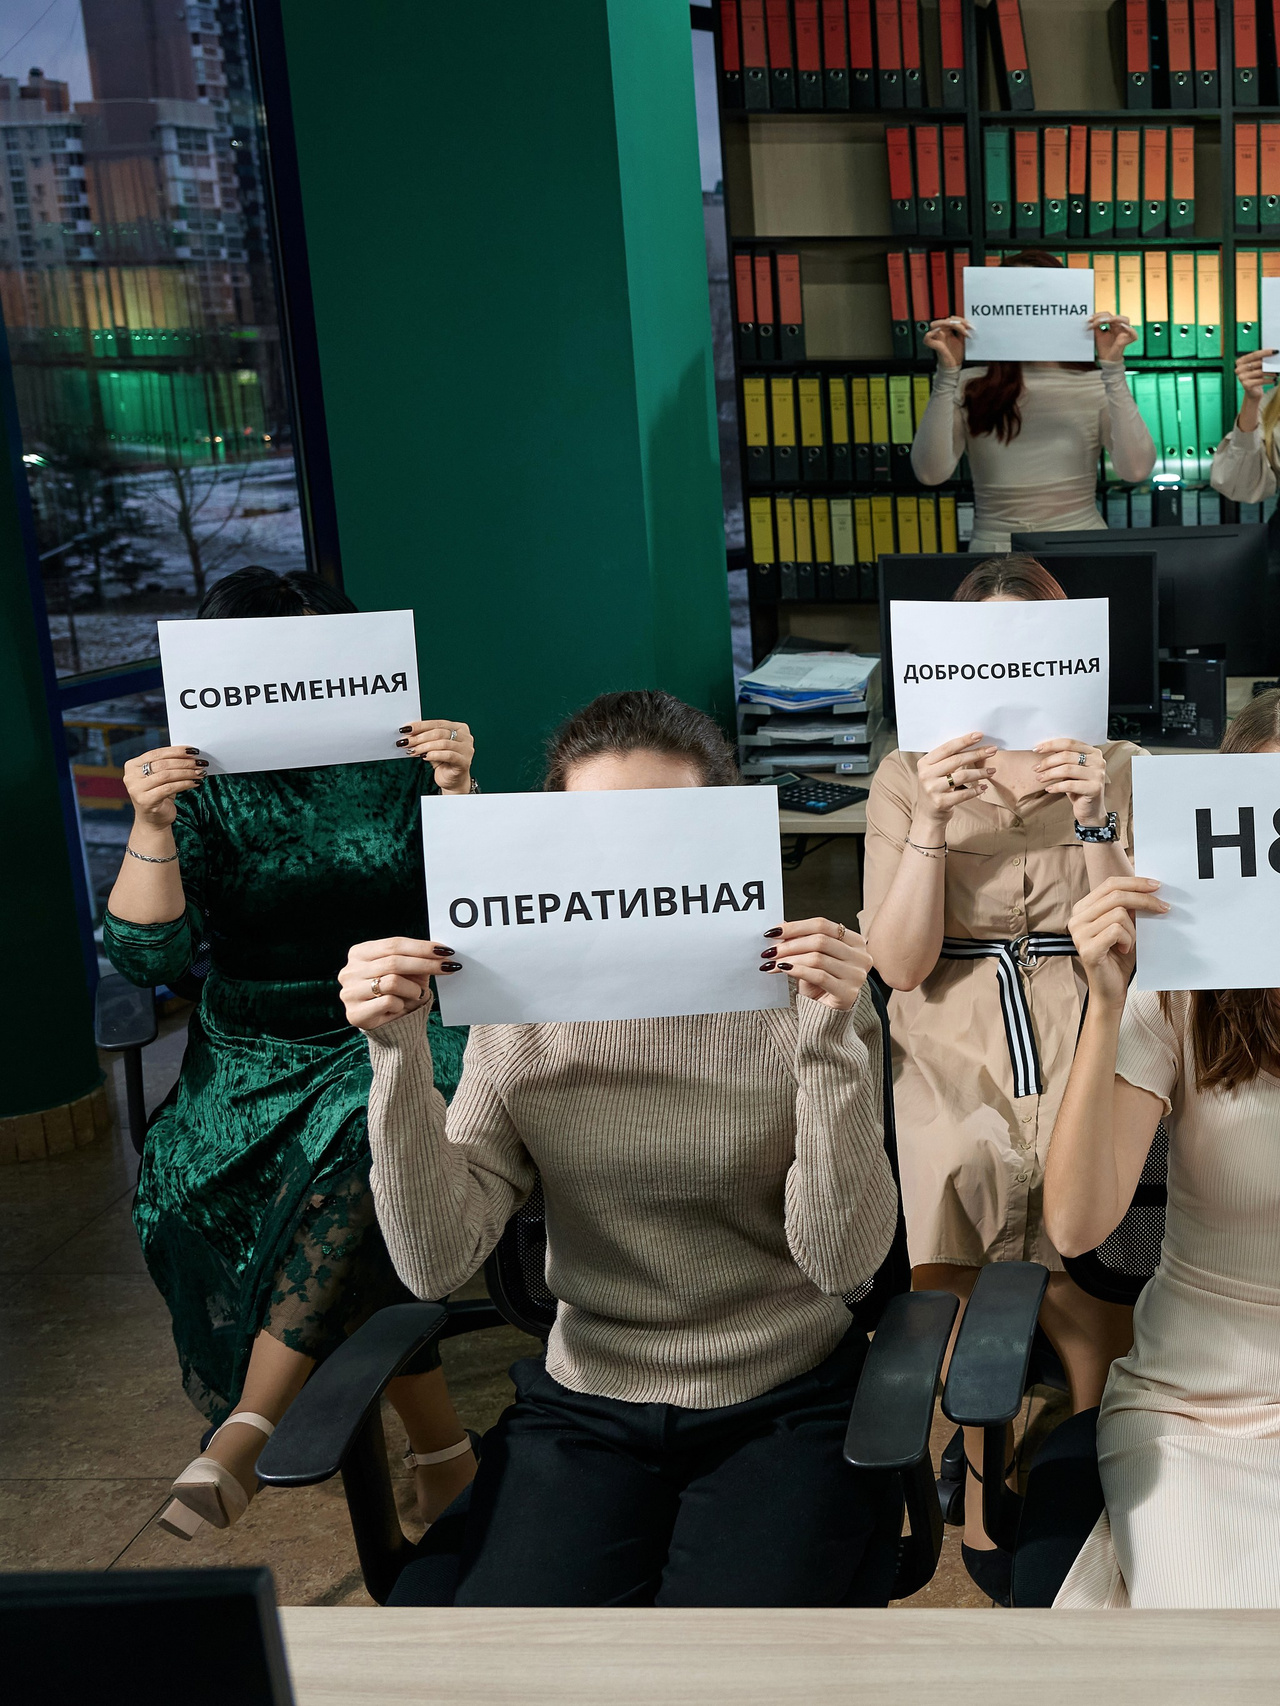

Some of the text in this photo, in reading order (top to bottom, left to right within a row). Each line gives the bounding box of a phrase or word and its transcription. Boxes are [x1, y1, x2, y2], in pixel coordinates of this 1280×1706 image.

[971, 304, 1088, 317] КОМПЕТЕНТНАЯ
[903, 657, 1100, 685] ДОБРОСОВЕСТНАЯ
[179, 671, 408, 710] СОВРЕМЕННАЯ
[448, 880, 766, 929] ОПЕРАТИВНАЯ
